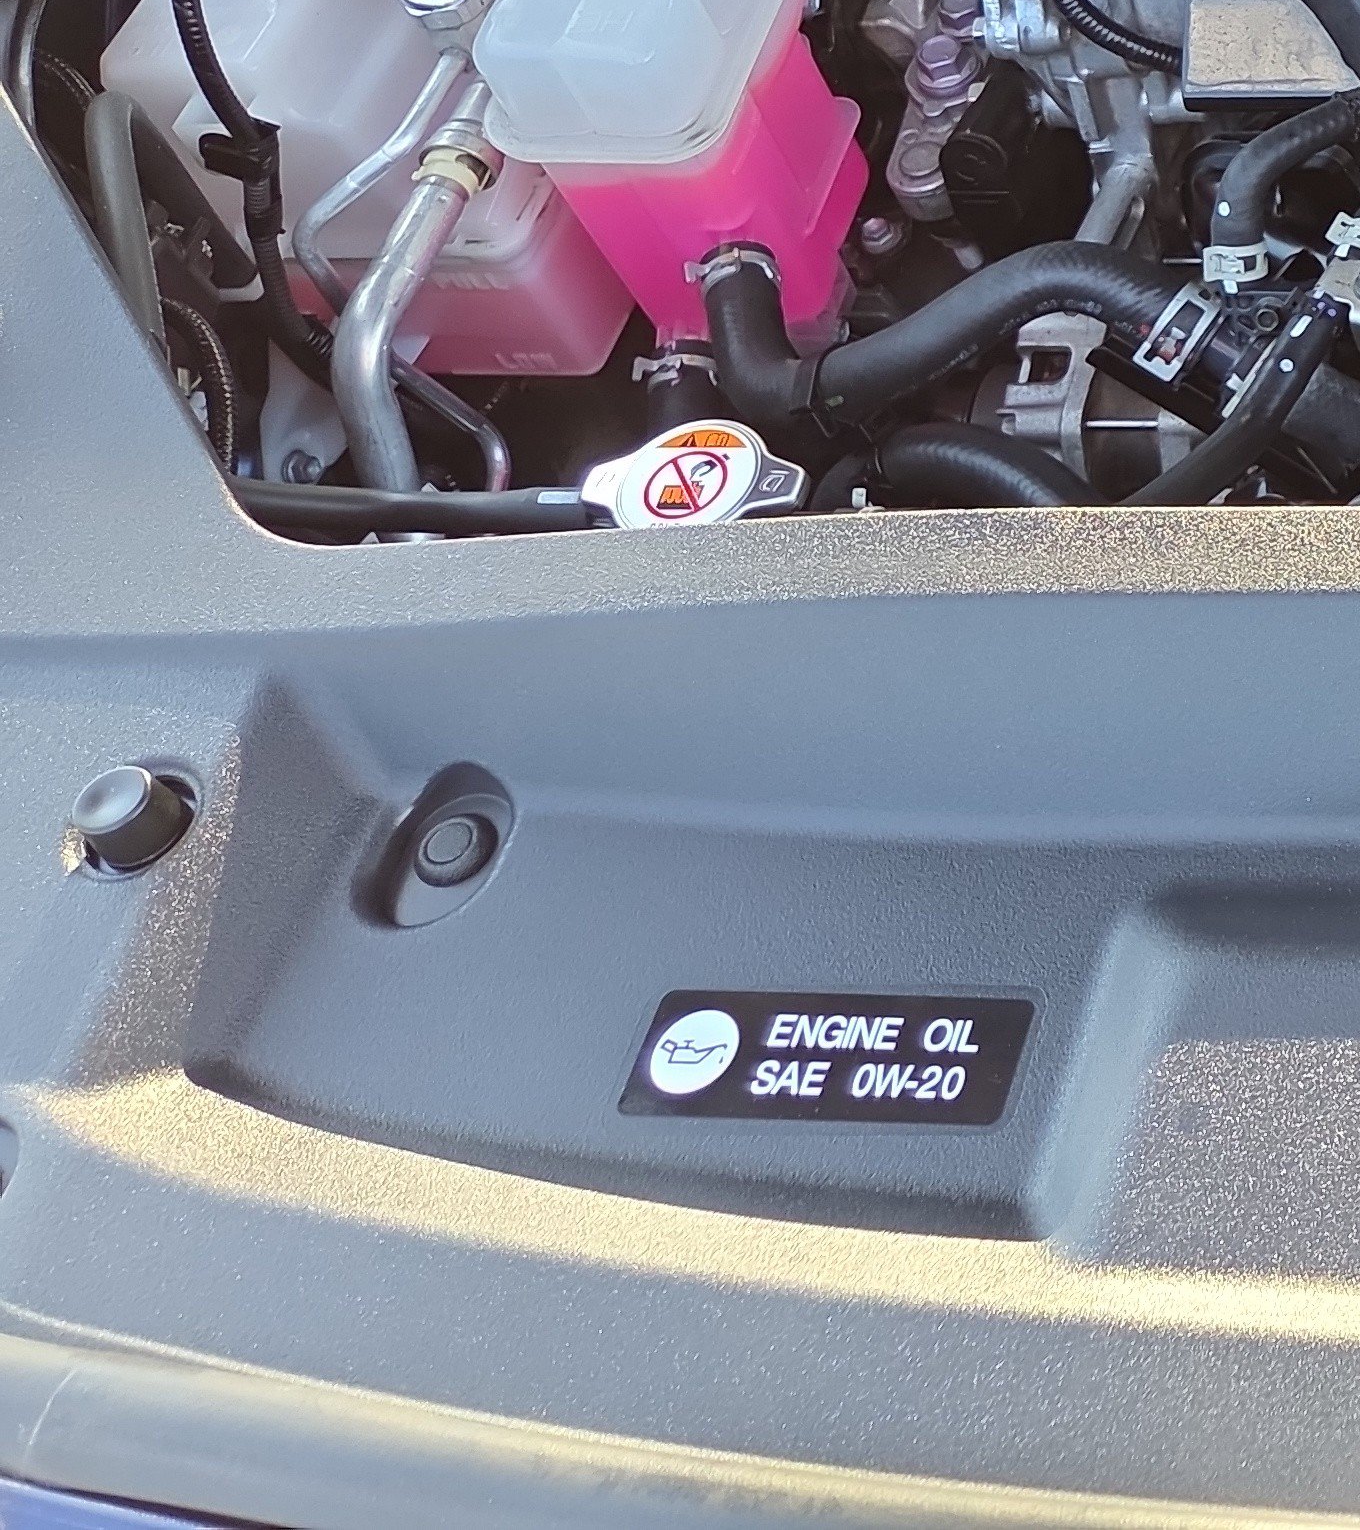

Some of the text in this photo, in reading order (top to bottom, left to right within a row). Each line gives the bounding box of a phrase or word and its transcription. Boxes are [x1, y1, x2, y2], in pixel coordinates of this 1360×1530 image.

[766, 1013, 980, 1054] ENGINE OIL
[749, 1060, 967, 1102] SAE 0W-20
